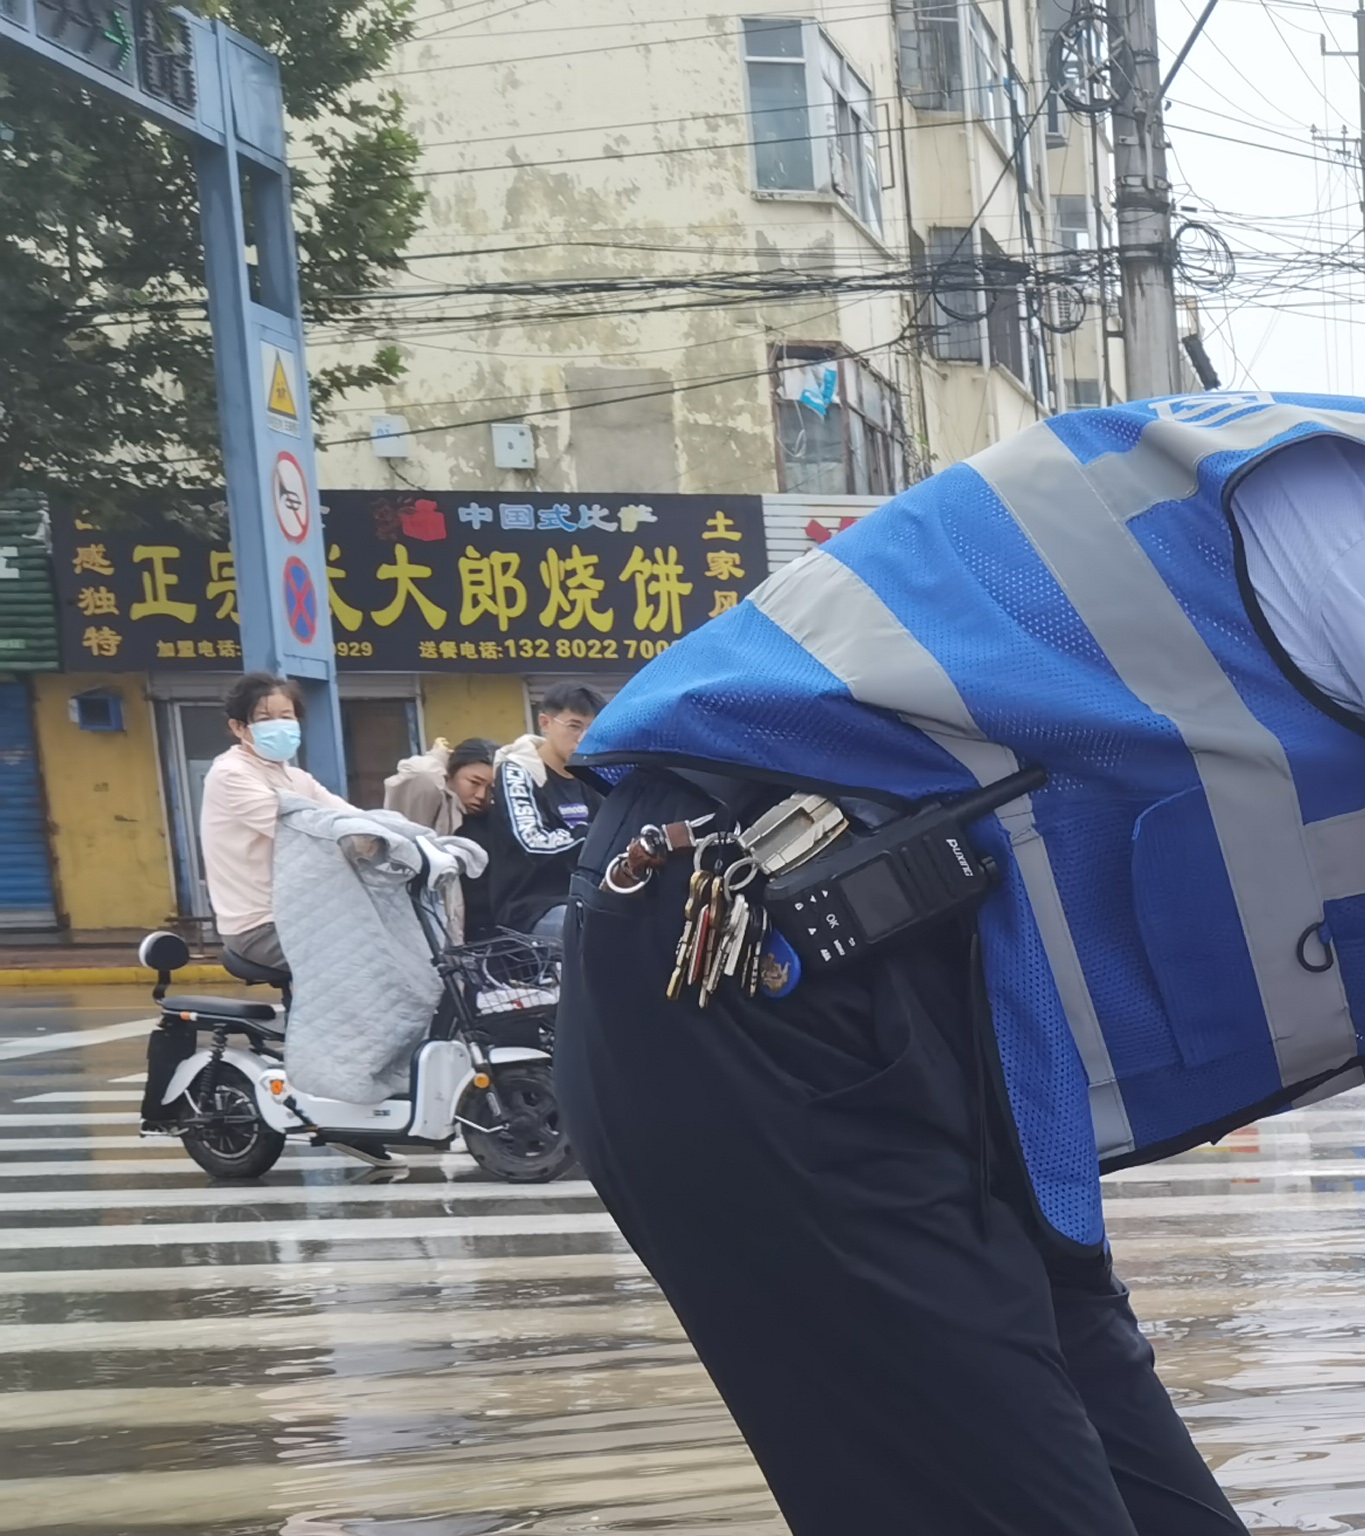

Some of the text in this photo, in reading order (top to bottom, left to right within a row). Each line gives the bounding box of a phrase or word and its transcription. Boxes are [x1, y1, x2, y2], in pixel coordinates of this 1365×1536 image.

[457, 502, 658, 533] 中国式比萨
[555, 639, 619, 659] 8022
[623, 639, 680, 660] 700
[826, 913, 840, 929] OK
